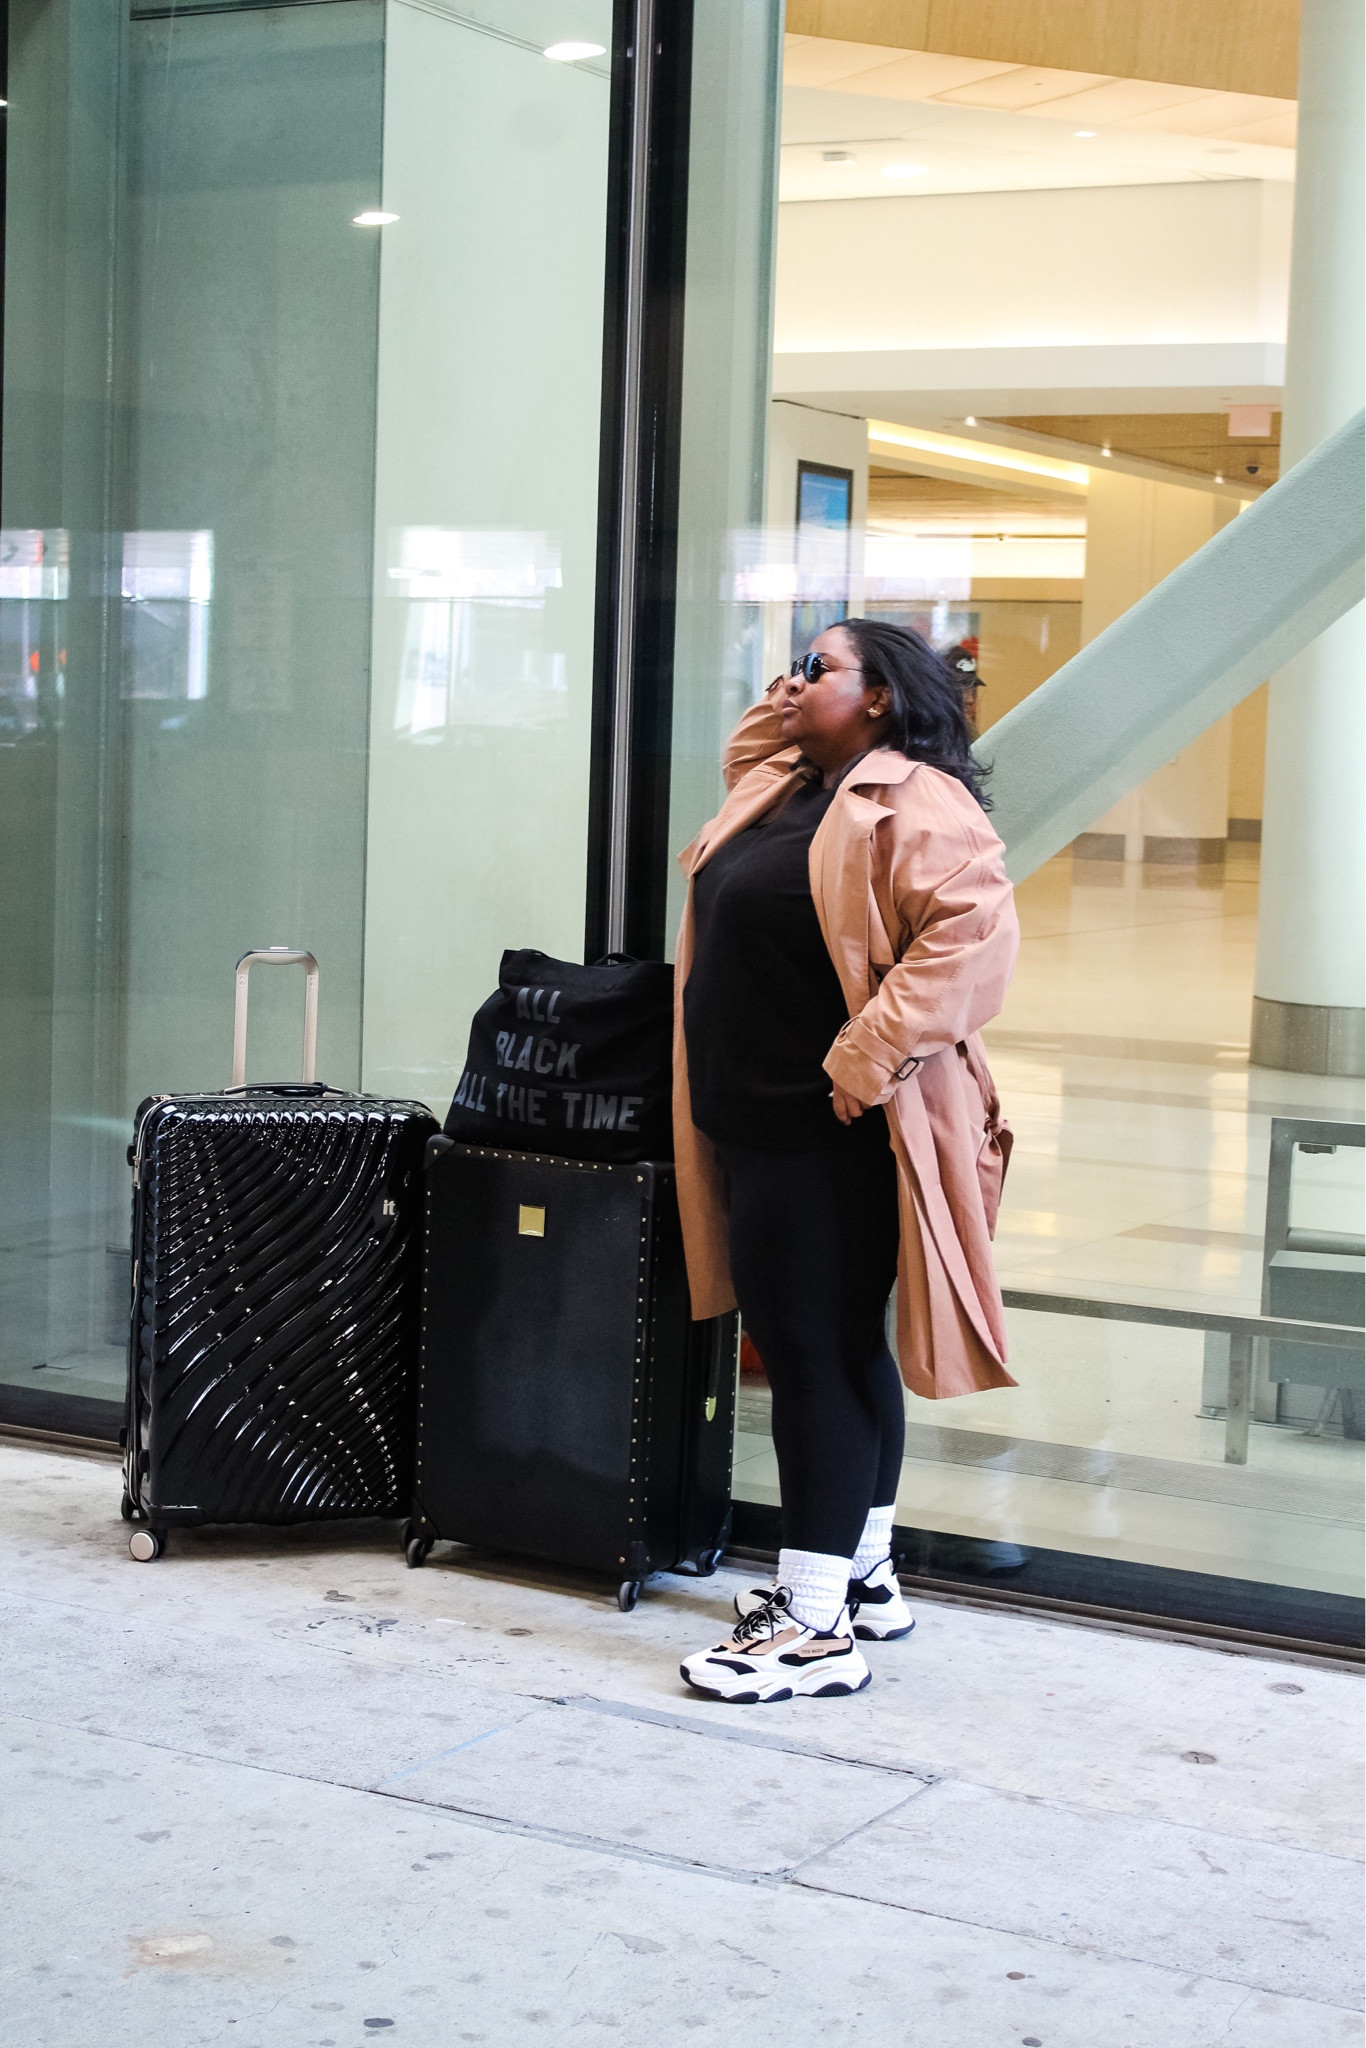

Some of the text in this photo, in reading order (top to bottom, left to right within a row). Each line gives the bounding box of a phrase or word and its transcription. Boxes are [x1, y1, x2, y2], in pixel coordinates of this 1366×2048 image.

[517, 987, 561, 1024] ALL
[495, 1030, 582, 1079] BLACK
[453, 1071, 644, 1132] ALL THE TIME
[382, 1199, 396, 1216] it
